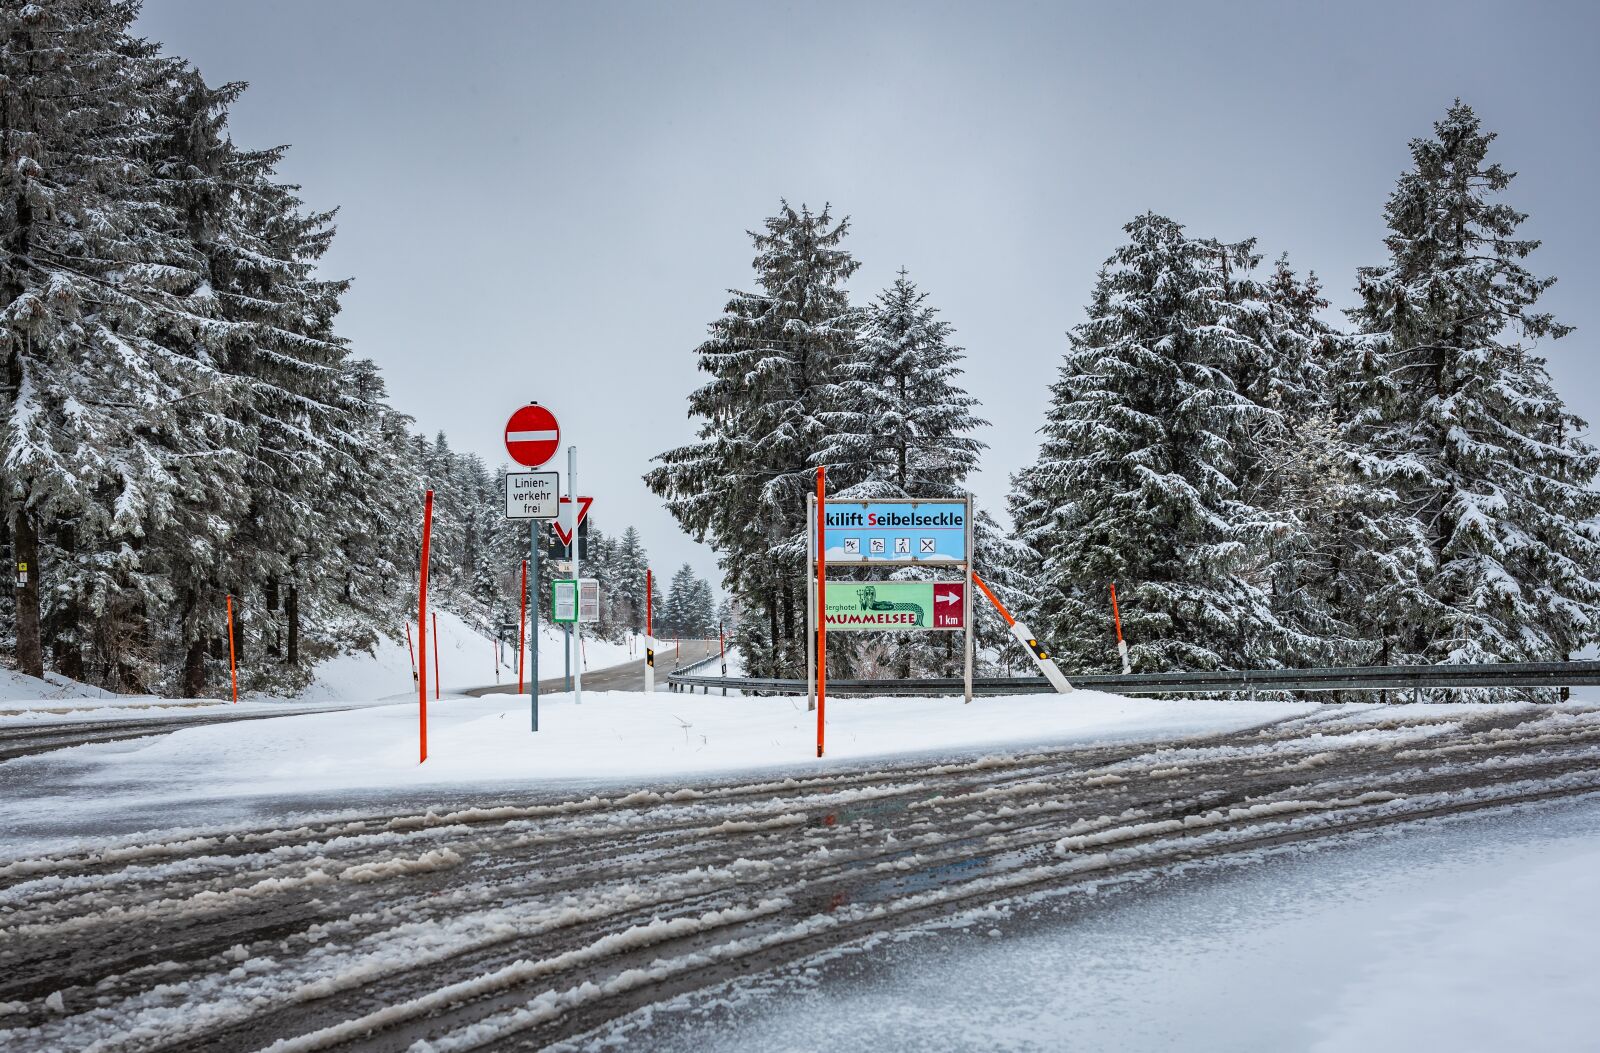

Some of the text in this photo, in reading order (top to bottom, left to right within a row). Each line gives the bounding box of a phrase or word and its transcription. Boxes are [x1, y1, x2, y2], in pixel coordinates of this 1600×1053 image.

[515, 478, 549, 488] Linien-
[513, 490, 551, 501] verkehr
[524, 503, 541, 513] frei
[824, 512, 963, 526] kilift Seibelseckle
[825, 613, 915, 624] MUMMELSEE
[938, 615, 958, 625] 1 km
